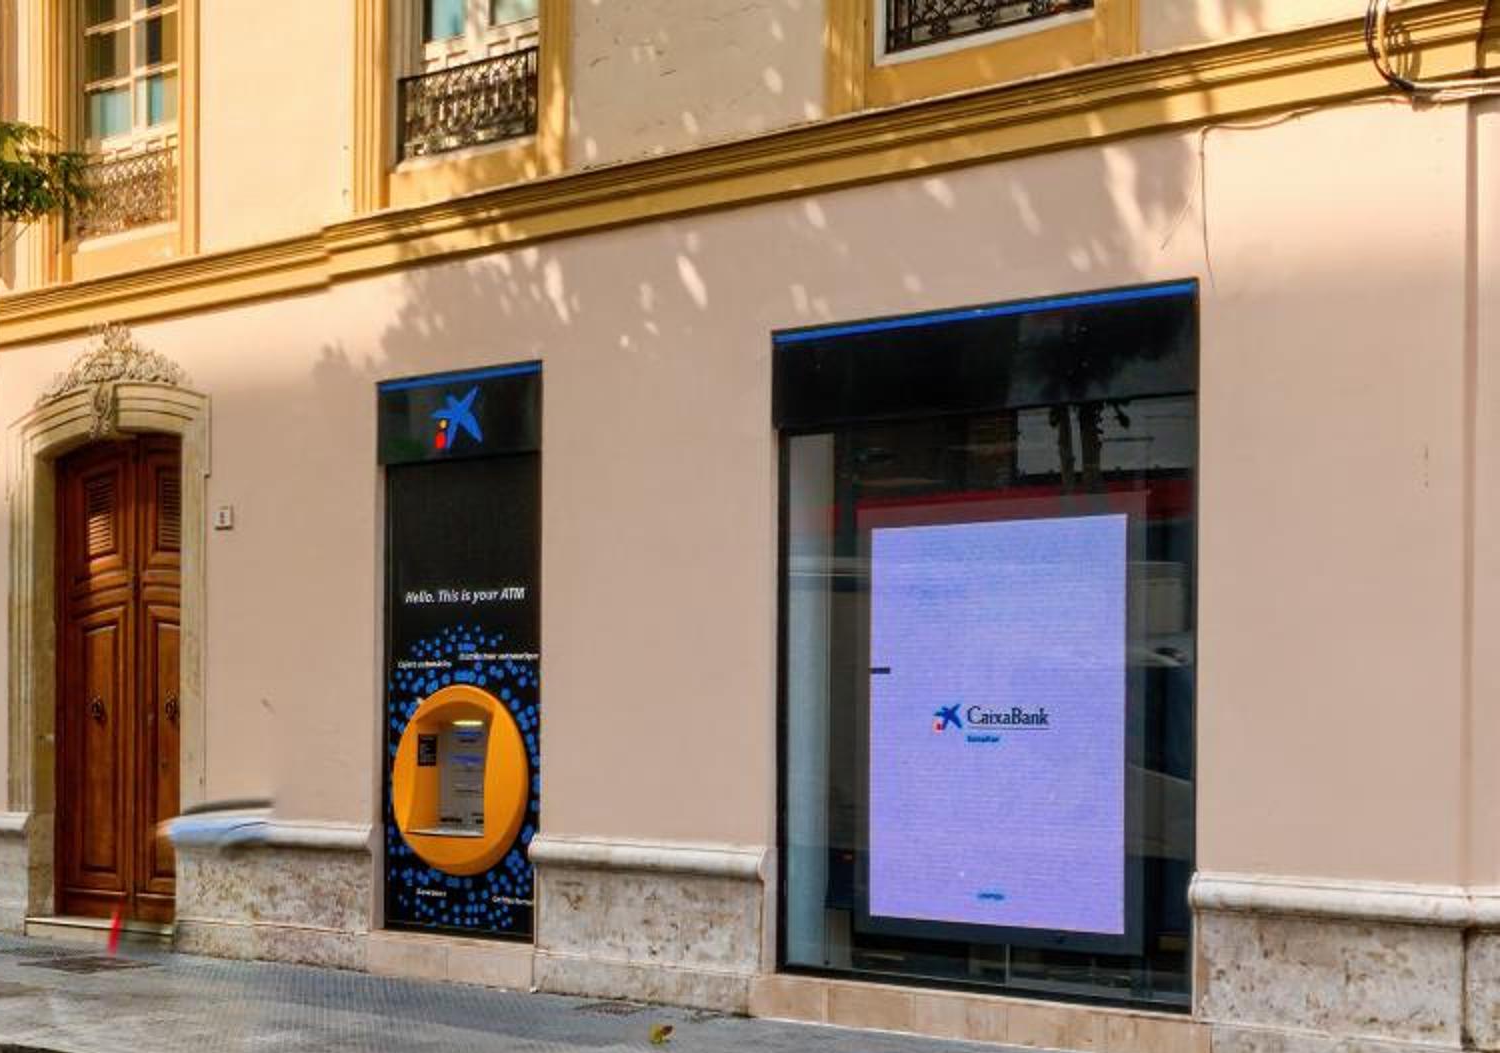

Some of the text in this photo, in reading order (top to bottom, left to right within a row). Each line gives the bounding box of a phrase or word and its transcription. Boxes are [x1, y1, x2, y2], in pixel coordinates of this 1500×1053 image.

[405, 587, 526, 604] Hello. This is your ATM
[967, 705, 1050, 725] CaixaBank
